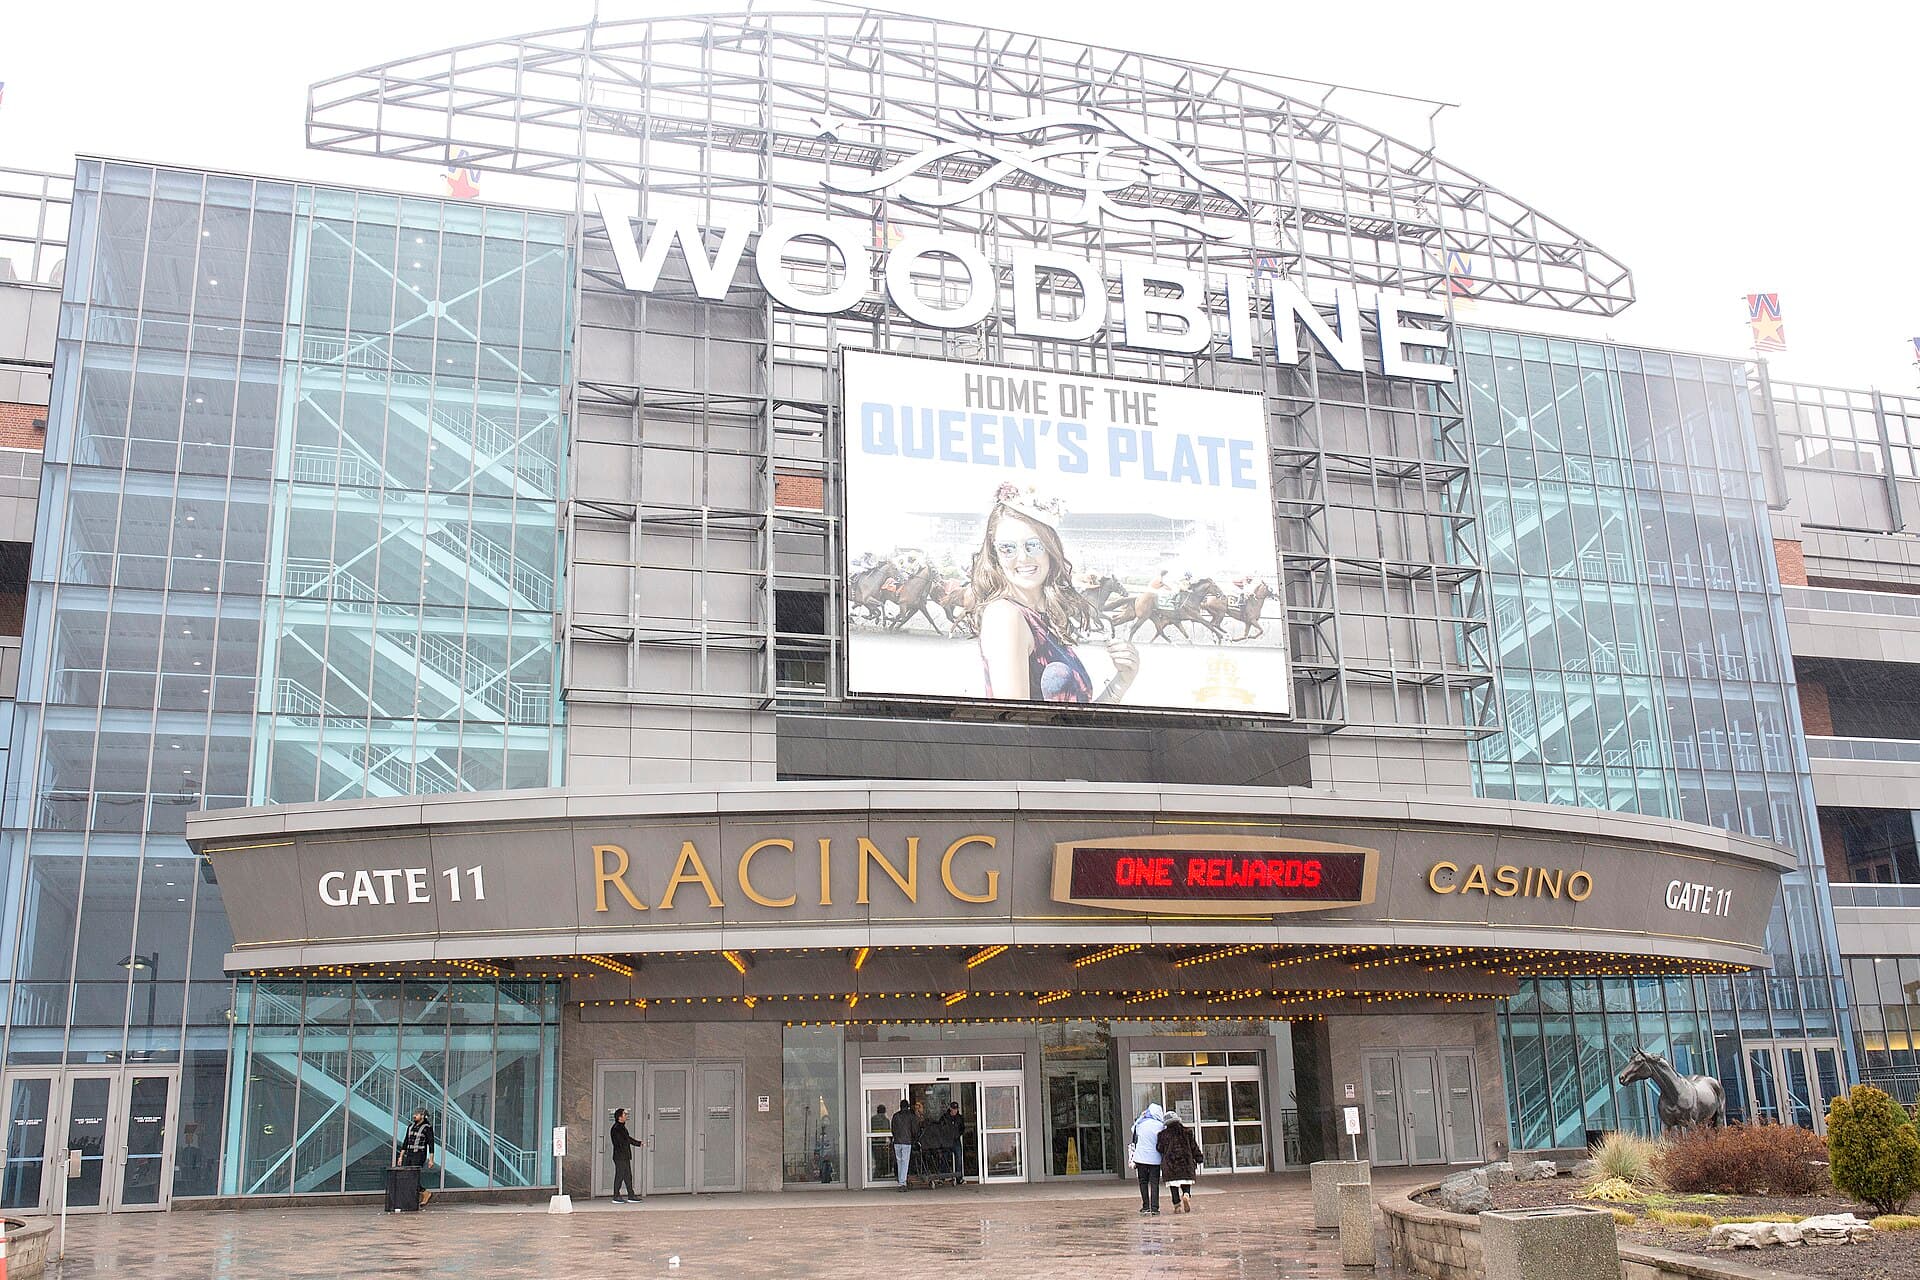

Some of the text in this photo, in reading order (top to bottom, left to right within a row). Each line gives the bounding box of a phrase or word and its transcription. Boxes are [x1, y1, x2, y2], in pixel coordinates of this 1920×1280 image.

[591, 191, 1456, 383] WOODBINE
[964, 373, 1159, 426] HOME OF THE
[861, 402, 1257, 490] QUEEN'S PLATE
[318, 864, 486, 906] GATE 11
[591, 835, 1000, 912] RACING
[1115, 857, 1323, 888] ONE REWARDS
[1429, 861, 1593, 902] CASINO
[1665, 879, 1732, 918] GATE 11
